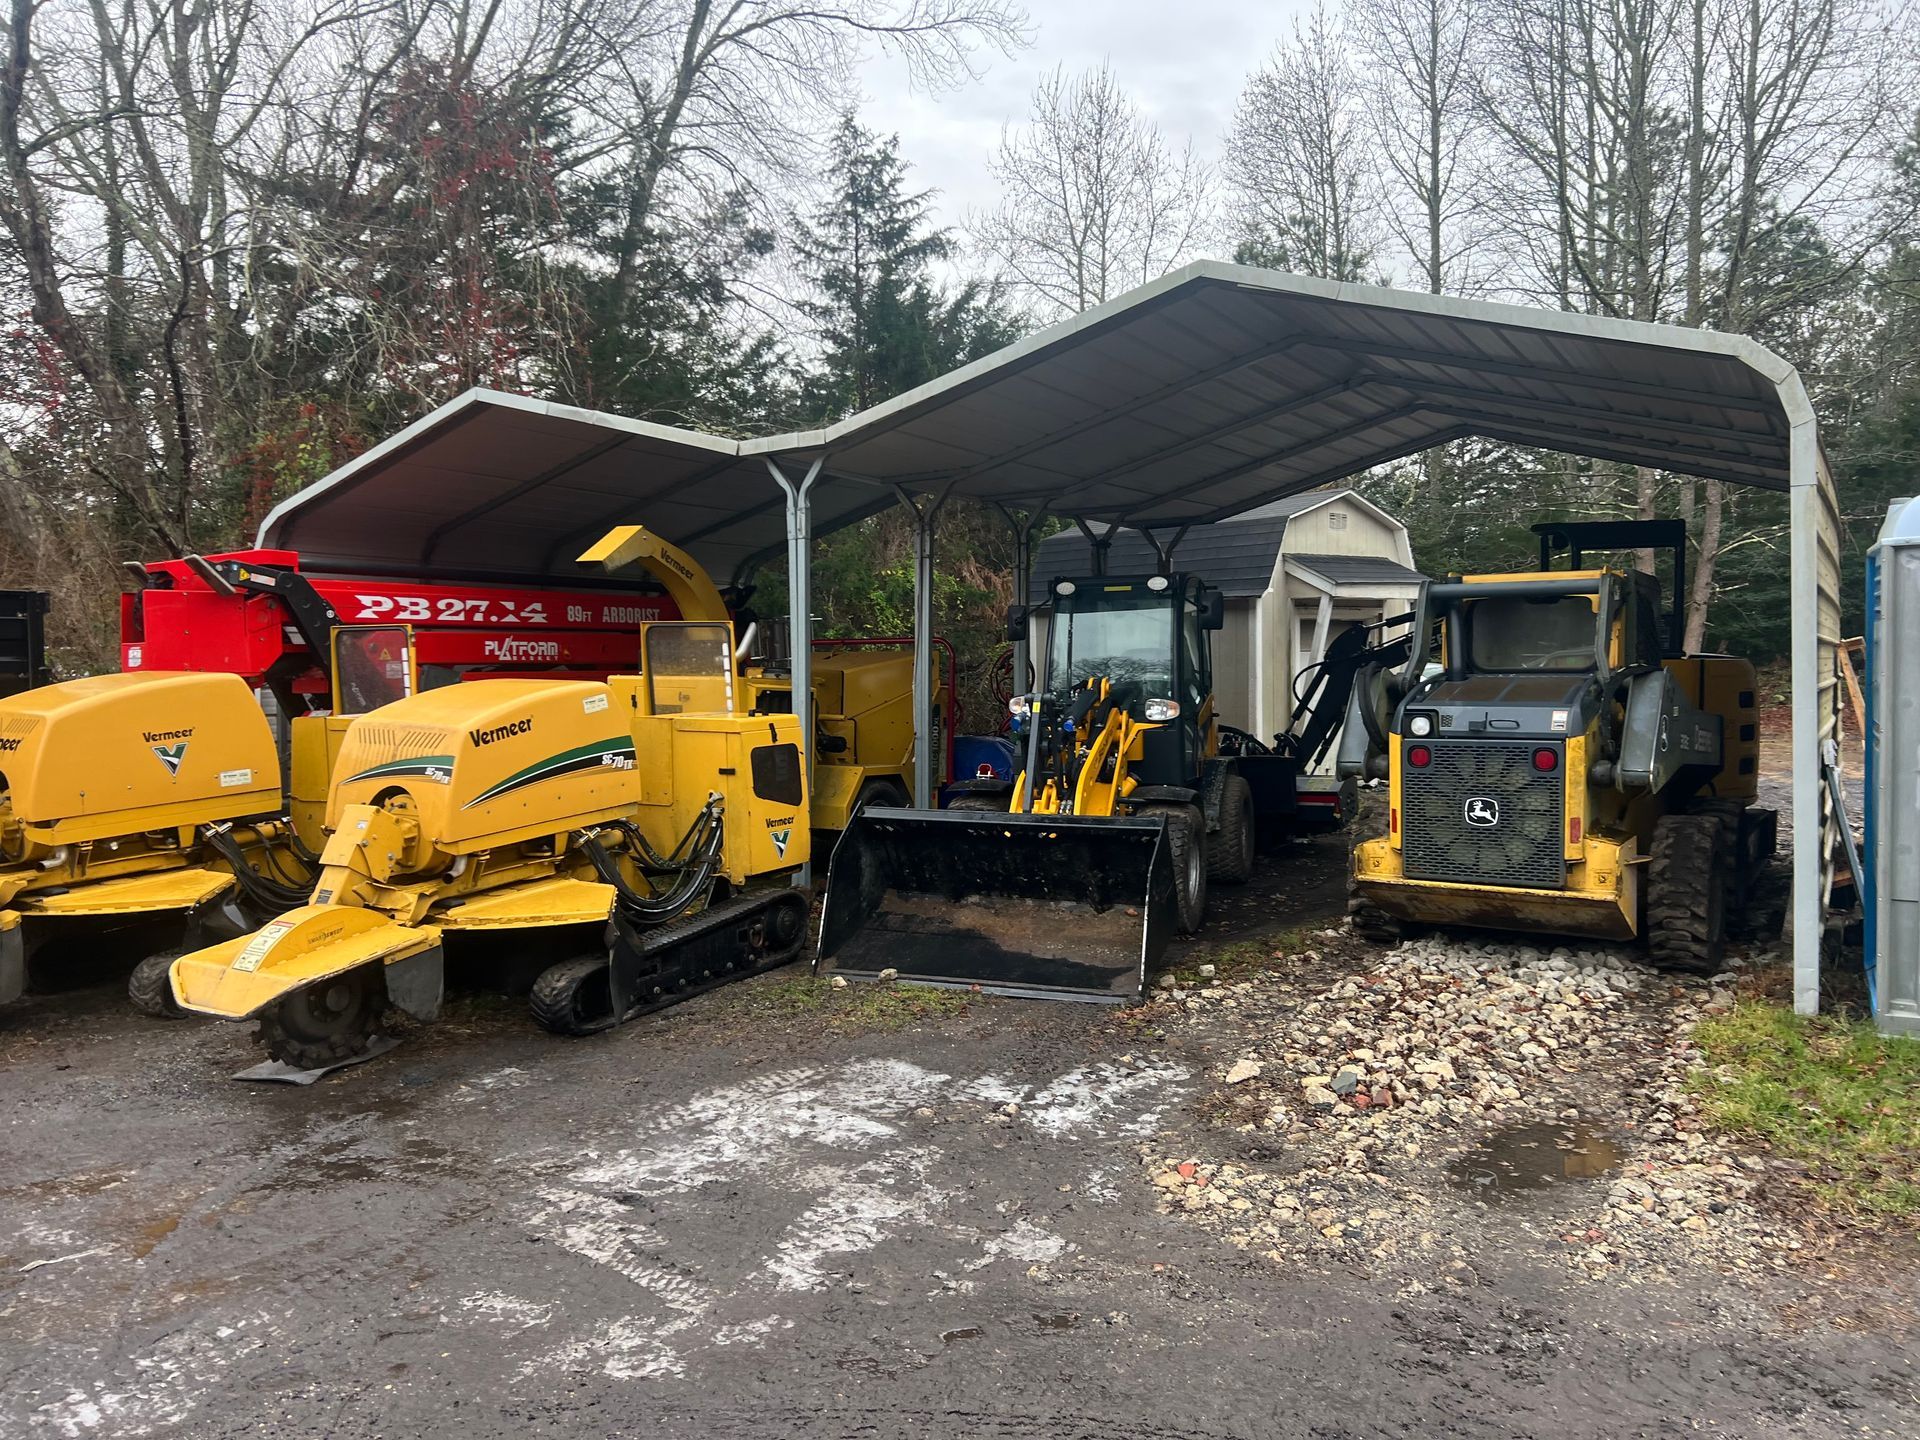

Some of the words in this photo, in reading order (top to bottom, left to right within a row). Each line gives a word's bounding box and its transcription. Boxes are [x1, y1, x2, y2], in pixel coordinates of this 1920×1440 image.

[660, 547, 694, 580] Vermeer
[602, 606, 660, 623] ARBORIST
[484, 635, 558, 661] PLATFORM
[143, 728, 193, 743] Vermeer
[468, 718, 532, 747] Vermeer
[765, 816, 795, 828] Vermeer
